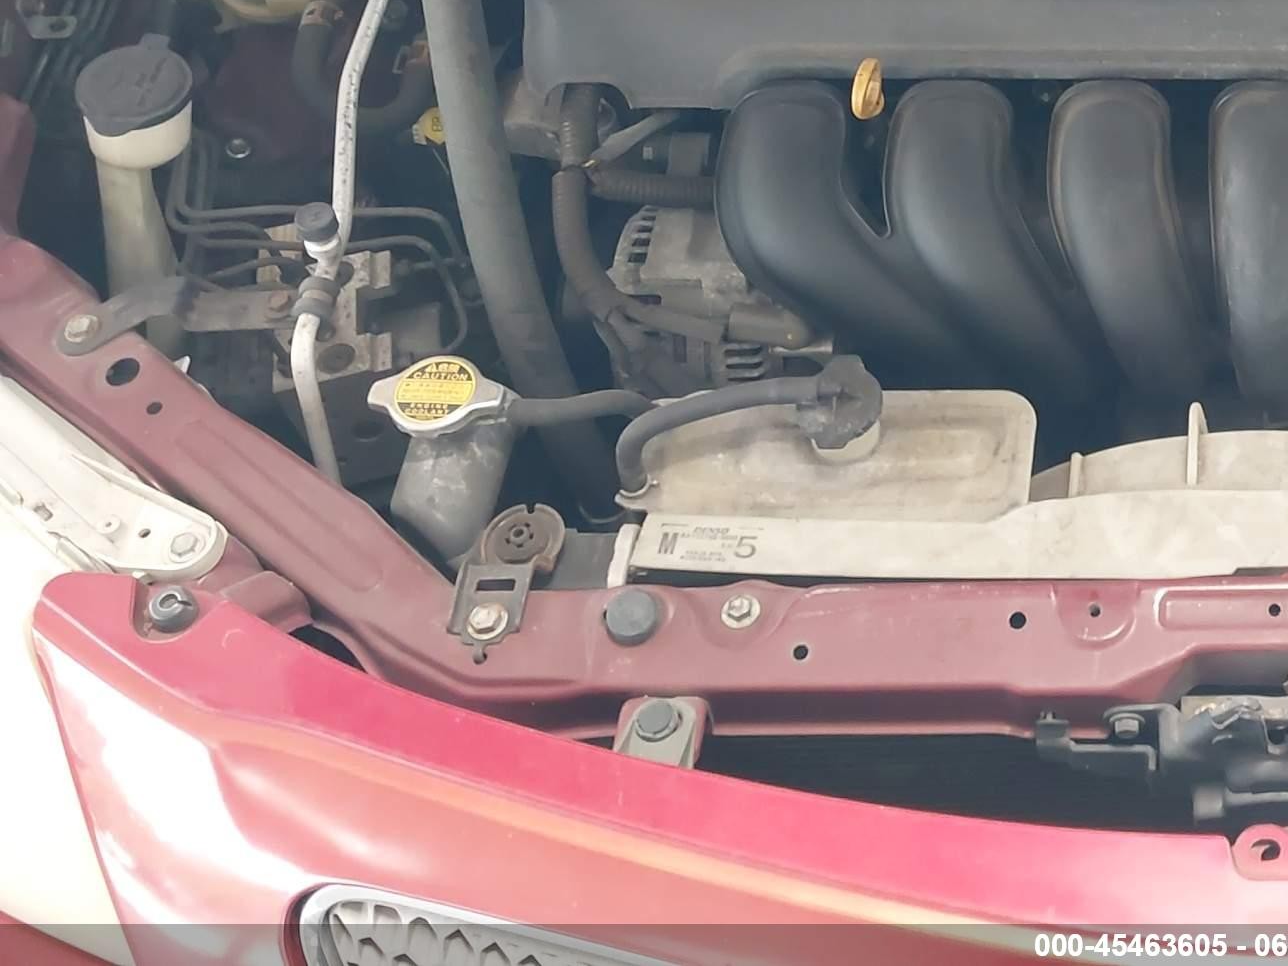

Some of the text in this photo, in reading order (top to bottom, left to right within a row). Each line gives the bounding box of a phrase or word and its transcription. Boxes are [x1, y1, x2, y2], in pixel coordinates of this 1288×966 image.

[413, 371, 468, 382] CAUTION
[657, 532, 679, 555] M
[734, 535, 758, 559] 5
